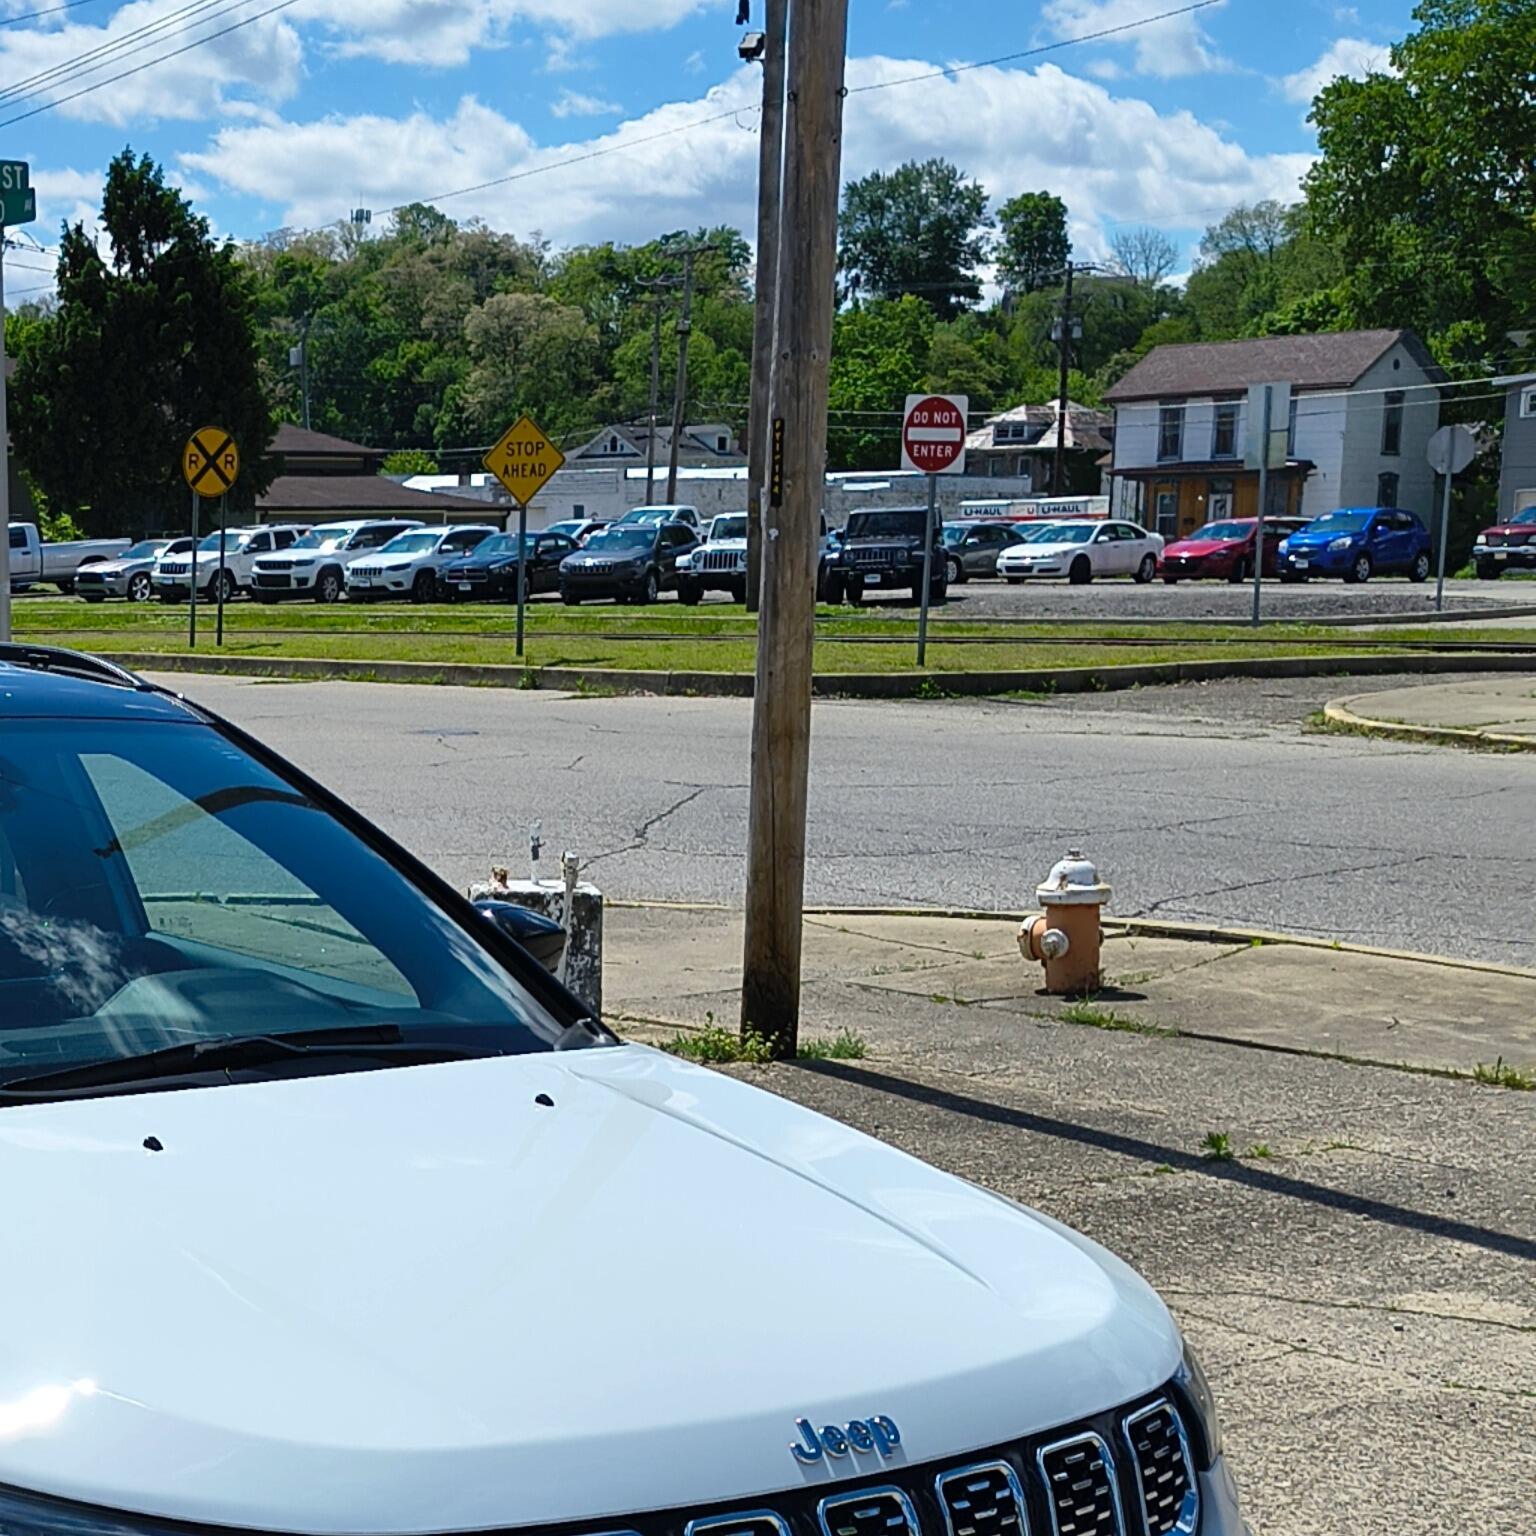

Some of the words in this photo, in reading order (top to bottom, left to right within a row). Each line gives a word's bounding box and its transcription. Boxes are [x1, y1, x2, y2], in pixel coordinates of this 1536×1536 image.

[2, 164, 24, 190] ST
[913, 411, 929, 424] DO
[933, 411, 957, 424] NOT
[506, 441, 545, 457] STOP
[913, 444, 953, 458] ENTER
[188, 453, 200, 470] R
[224, 453, 235, 470] R
[503, 463, 547, 478] AHEAD
[789, 1415, 902, 1464] Jeep
